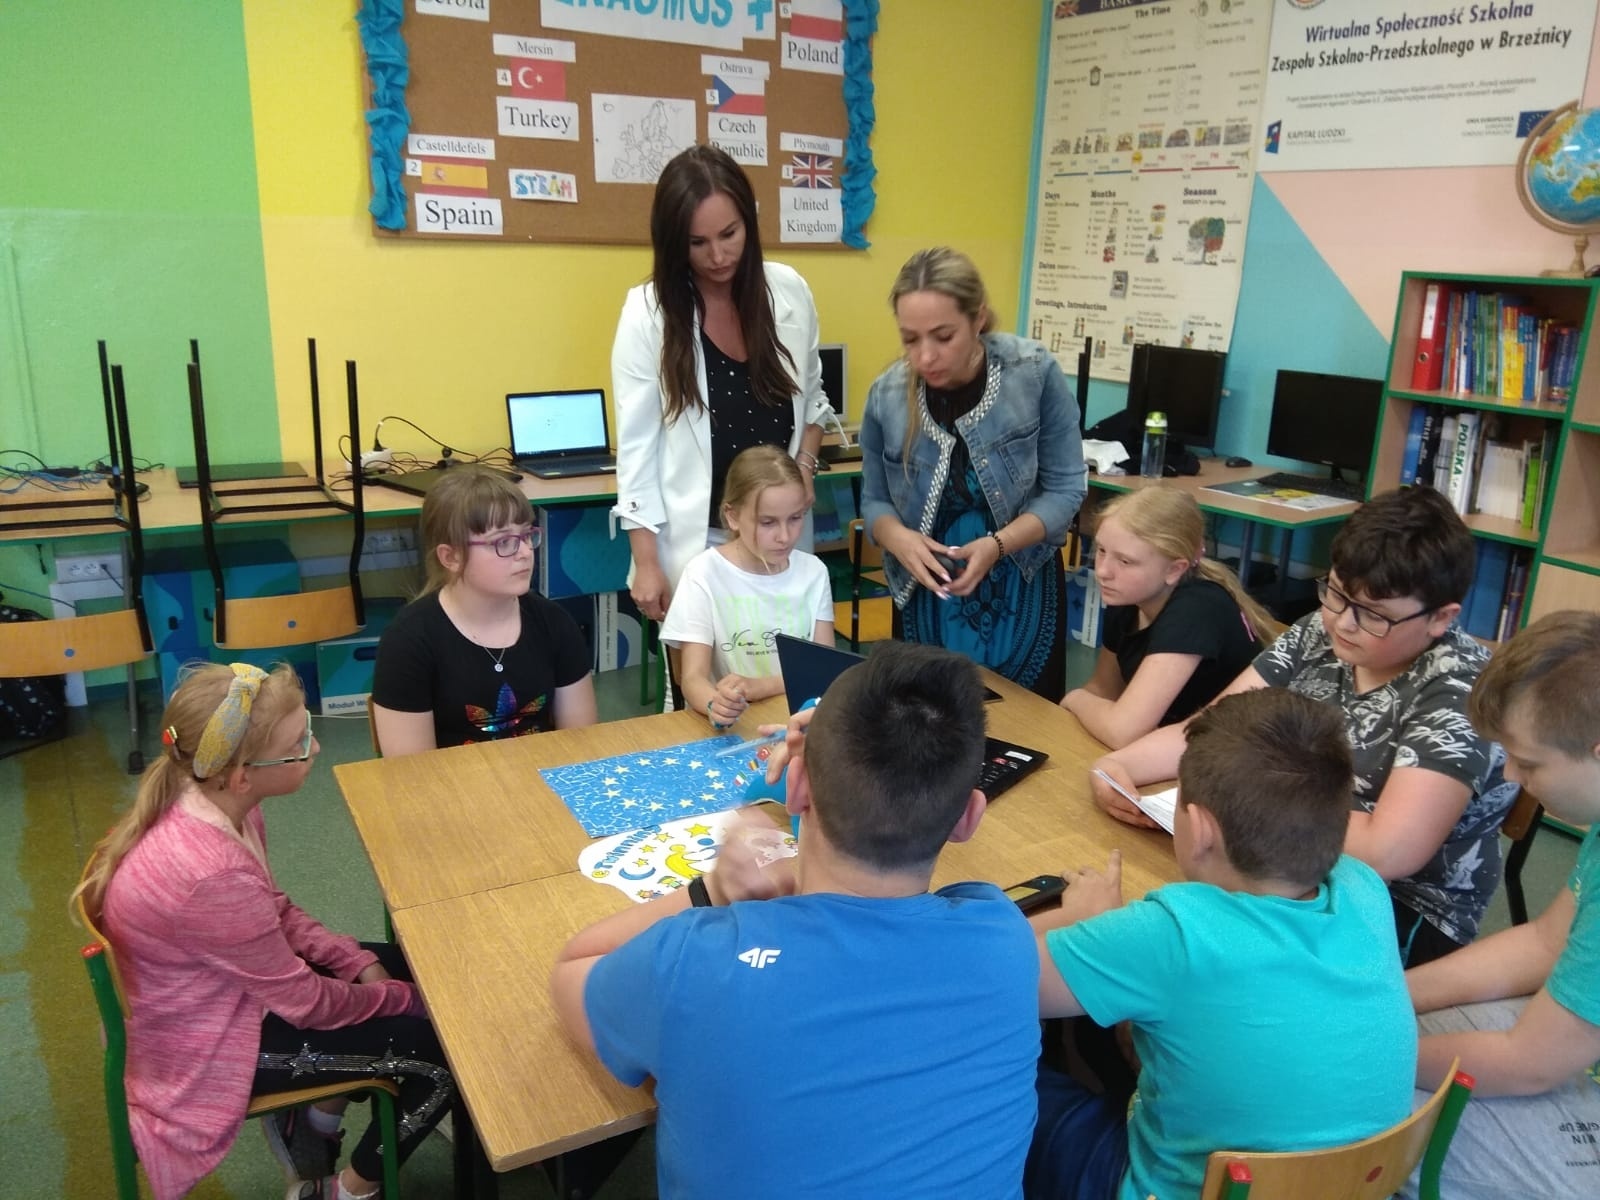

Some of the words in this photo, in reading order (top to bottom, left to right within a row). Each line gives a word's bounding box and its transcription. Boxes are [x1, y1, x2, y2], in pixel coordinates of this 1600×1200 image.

[782, 5, 789, 15] 6
[1135, 9, 1149, 18] The
[1151, 6, 1171, 16] Time
[1306, 20, 1370, 43] Wirtualna
[1376, 7, 1464, 38] Społeczność
[1469, 0, 1534, 23] Szkolna
[516, 41, 554, 57] Mersin
[788, 41, 839, 65] Poland
[1272, 52, 1315, 74] Zespołu
[1319, 36, 1475, 67] Szkolno-Przedszkolnego
[1480, 36, 1494, 50] w
[1499, 26, 1572, 48] Brzeźnicy
[719, 61, 753, 75] Ostrava
[501, 72, 509, 83] 4
[709, 92, 716, 102] 5
[504, 106, 571, 135] Turkey
[718, 117, 756, 135] Czech
[416, 139, 487, 155] Castelldefels
[793, 138, 830, 153] Plymouth
[410, 162, 418, 172] 2
[786, 168, 791, 177] 1
[1044, 191, 1061, 201] Days
[1091, 189, 1117, 199] Months
[1183, 187, 1217, 197] Seasons
[793, 197, 829, 211] United
[425, 199, 494, 230] Spain
[786, 219, 837, 236] Kingdom
[1038, 261, 1056, 271] Dates
[1067, 300, 1108, 312] Introduction
[1454, 423, 1469, 475] POLSKA
[738, 947, 782, 969] 4F
